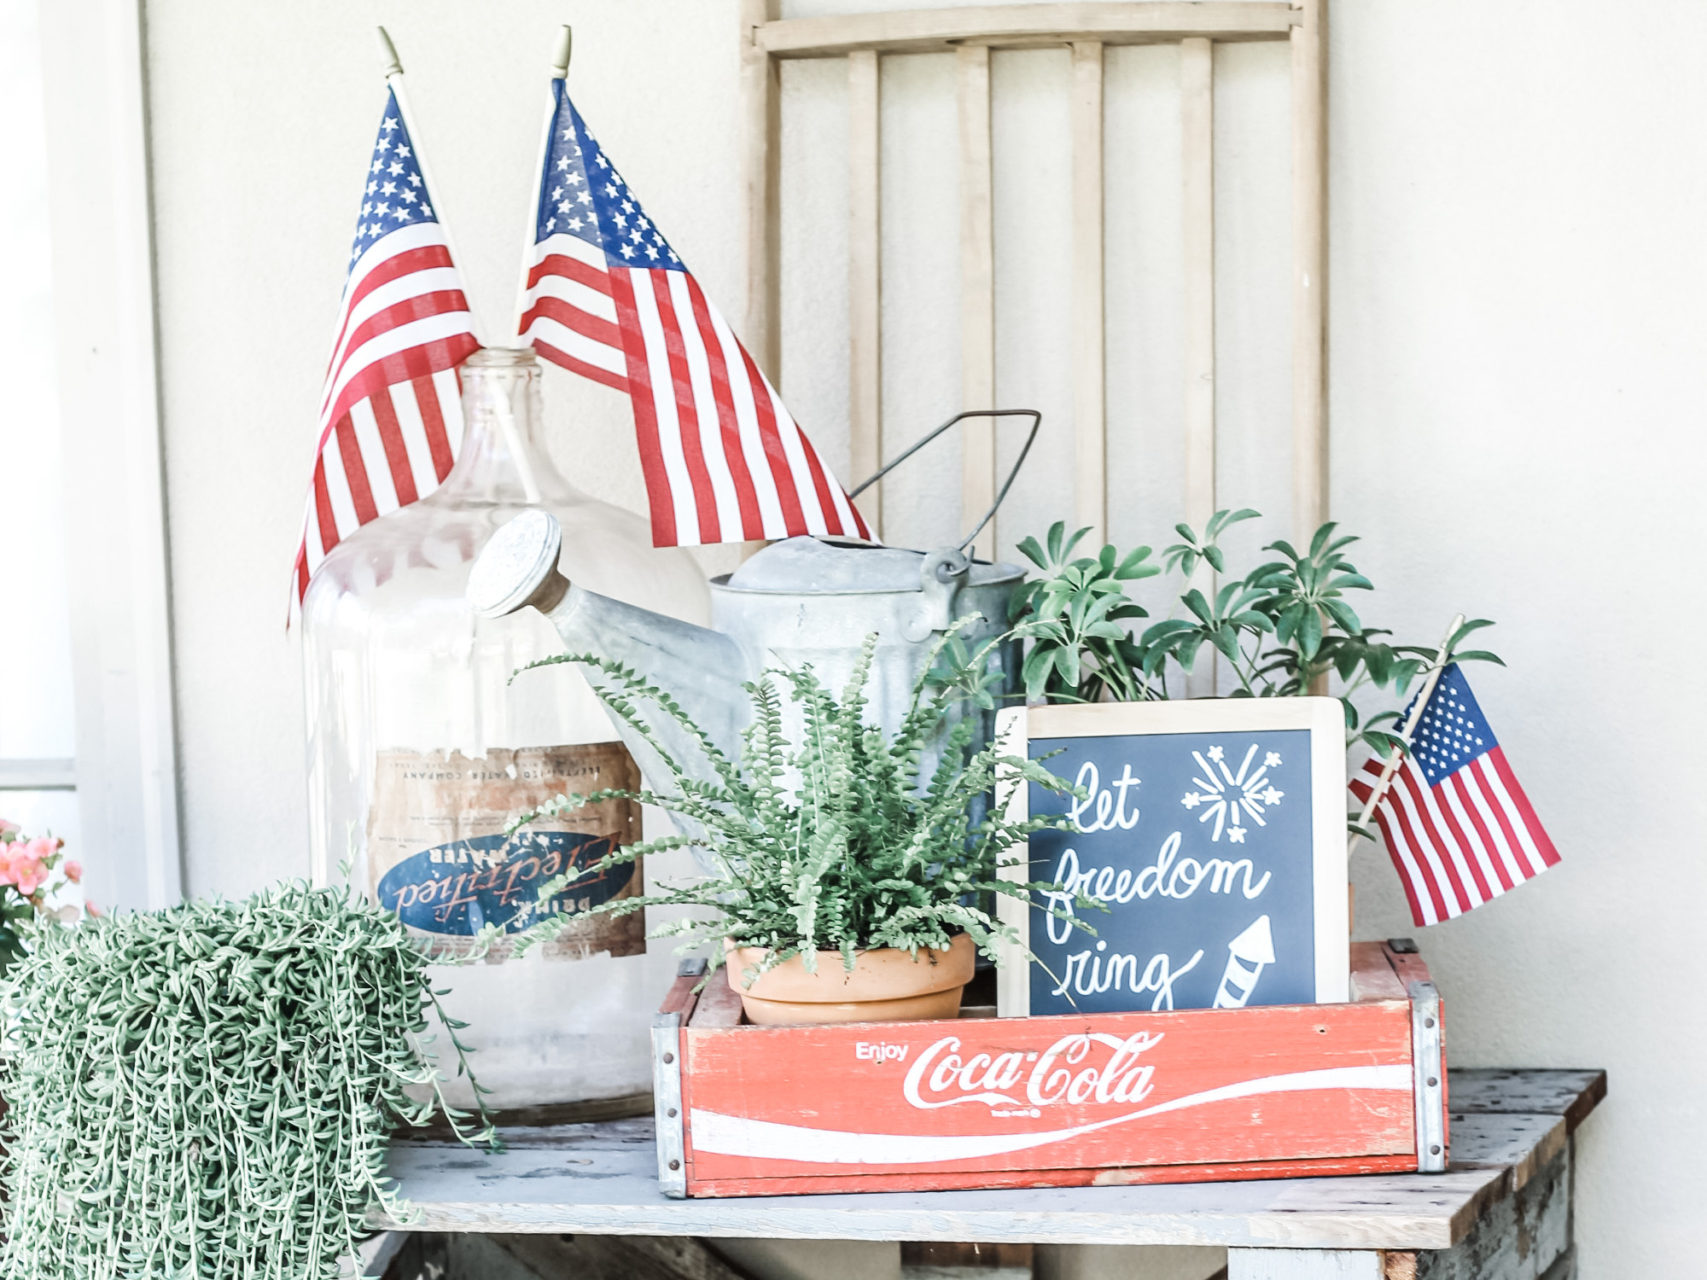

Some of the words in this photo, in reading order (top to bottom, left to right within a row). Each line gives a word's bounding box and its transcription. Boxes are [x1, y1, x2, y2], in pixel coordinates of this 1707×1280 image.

[1065, 761, 1142, 833] let
[1040, 831, 1272, 945] freedom
[1051, 940, 1205, 1011] ring
[855, 1041, 909, 1062] Enjoy
[903, 1031, 1165, 1110] Coca-Cola
